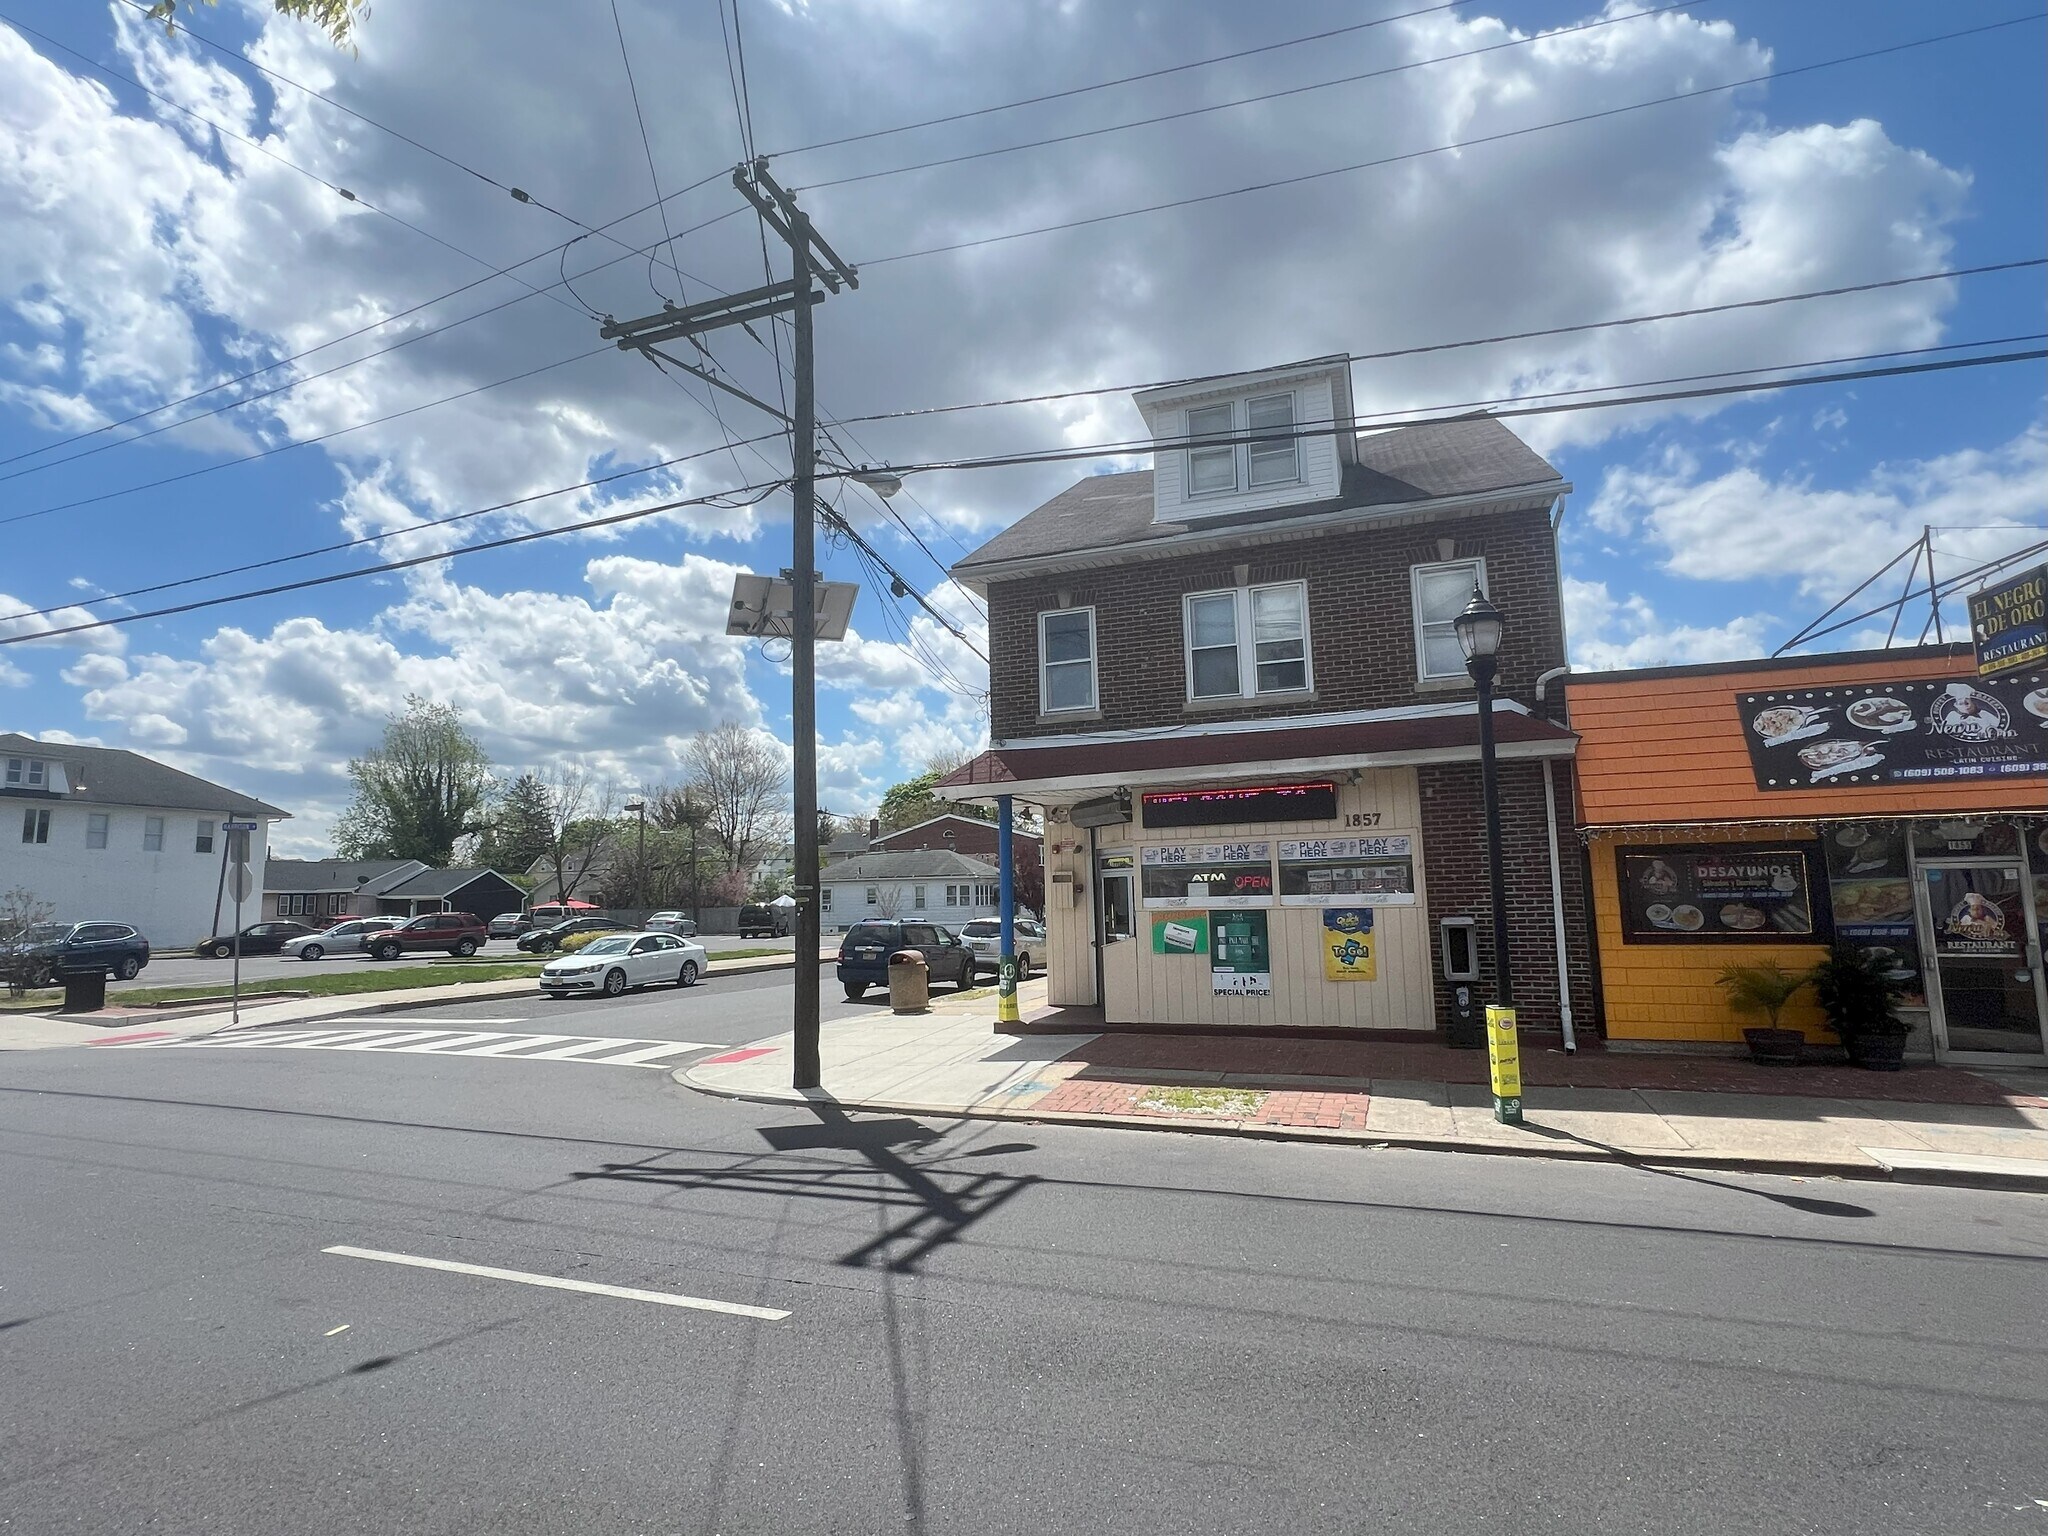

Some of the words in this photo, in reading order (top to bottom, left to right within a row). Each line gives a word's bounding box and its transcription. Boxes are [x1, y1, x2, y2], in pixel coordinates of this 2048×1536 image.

[1974, 600, 1991, 620] EL
[1993, 578, 2046, 612] NEGRO
[1987, 613, 2008, 635] DE
[2011, 599, 2045, 626] ORO
[1983, 632, 2047, 661] RESTAURANT
[1925, 743, 2040, 759] RESTAURANT
[1903, 767, 1931, 777] (609)
[1933, 765, 1984, 776] 508-1083
[2000, 763, 2030, 773] (609)
[2032, 762, 2048, 771] 39
[1345, 812, 1381, 828] 1857
[1299, 841, 1328, 849] PLAY
[1360, 838, 1388, 847] PLAY
[1161, 847, 1186, 855] PLAY
[1223, 844, 1250, 852] PLAY
[1360, 846, 1388, 855] HERE
[1223, 852, 1250, 860] HERE
[1300, 849, 1328, 858] HERE
[1161, 855, 1186, 863] HERE
[1697, 865, 1792, 878] DESAYUNOS
[1191, 873, 1226, 882] ATM
[1234, 877, 1270, 889] OPEN
[1946, 941, 2016, 949] RESTAURANT
[1333, 946, 1346, 956] To
[1347, 946, 1367, 956] Go!
